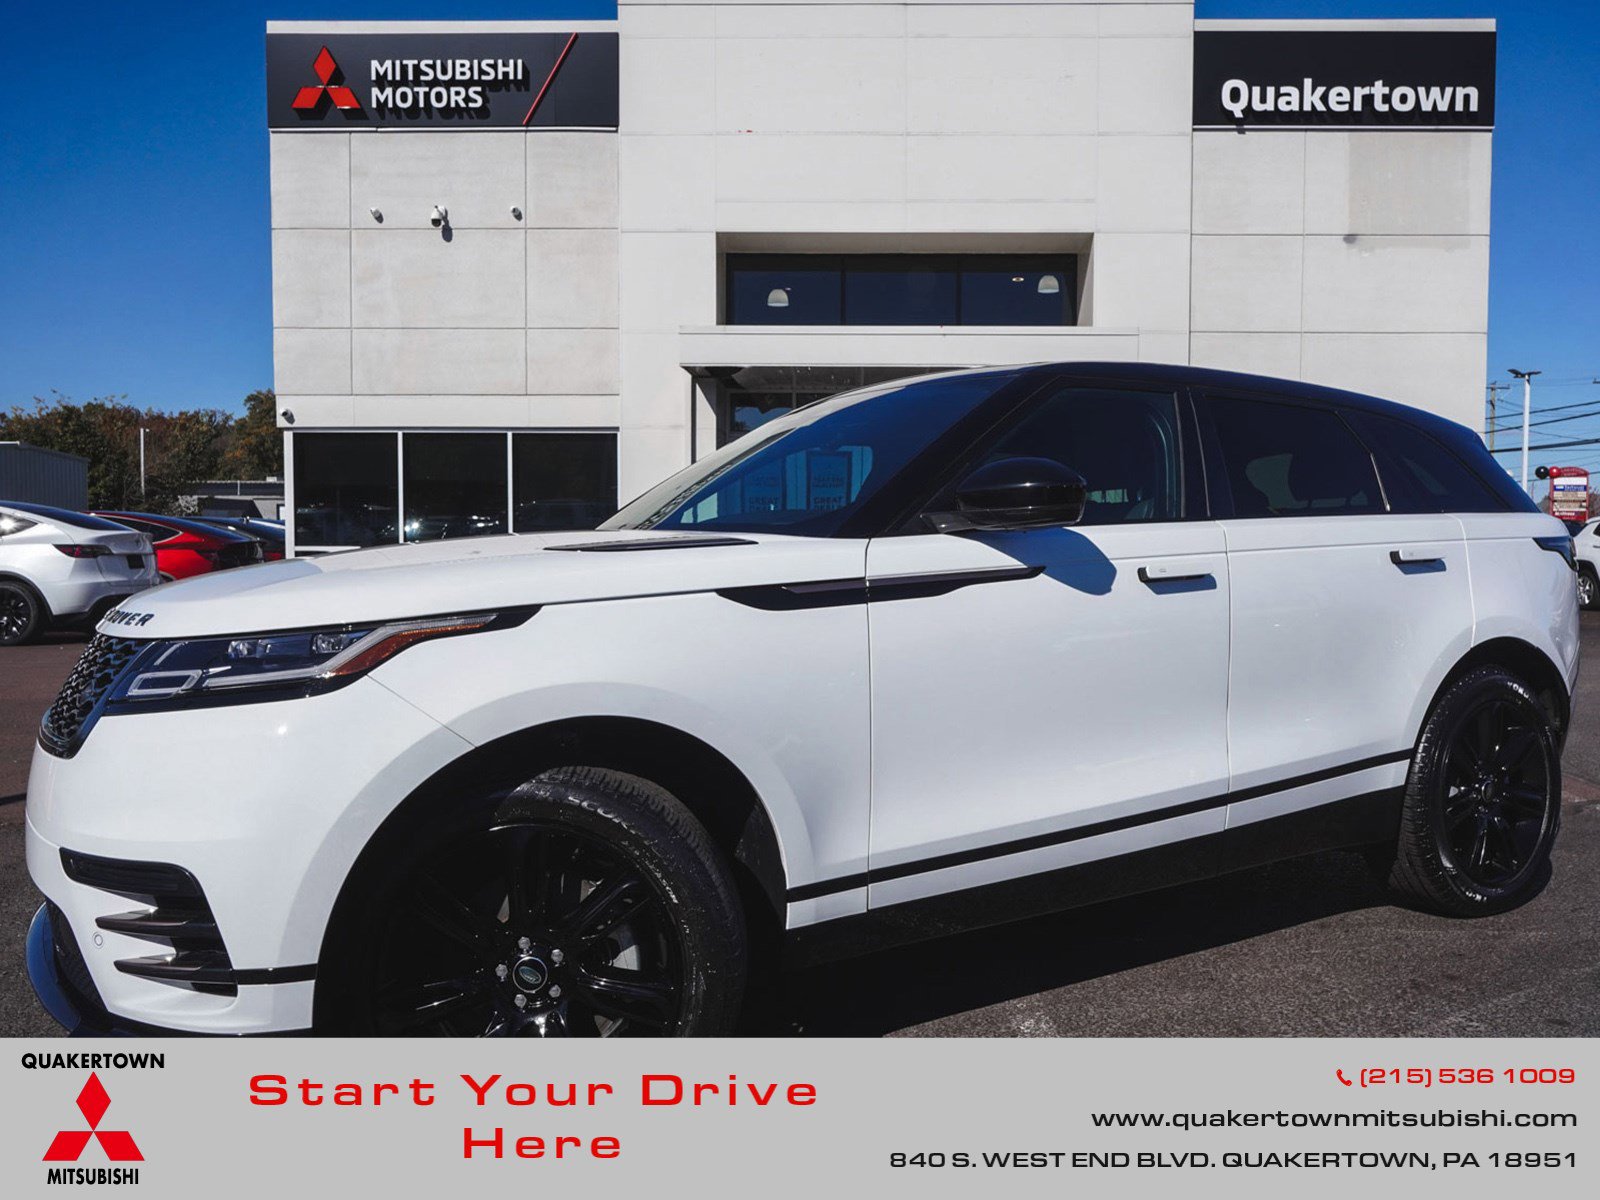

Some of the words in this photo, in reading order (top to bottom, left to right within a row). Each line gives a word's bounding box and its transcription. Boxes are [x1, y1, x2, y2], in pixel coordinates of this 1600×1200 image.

[370, 59, 523, 81] MITSUBISHI
[371, 87, 483, 108] MOTORS
[1221, 78, 1479, 118] Quakertown
